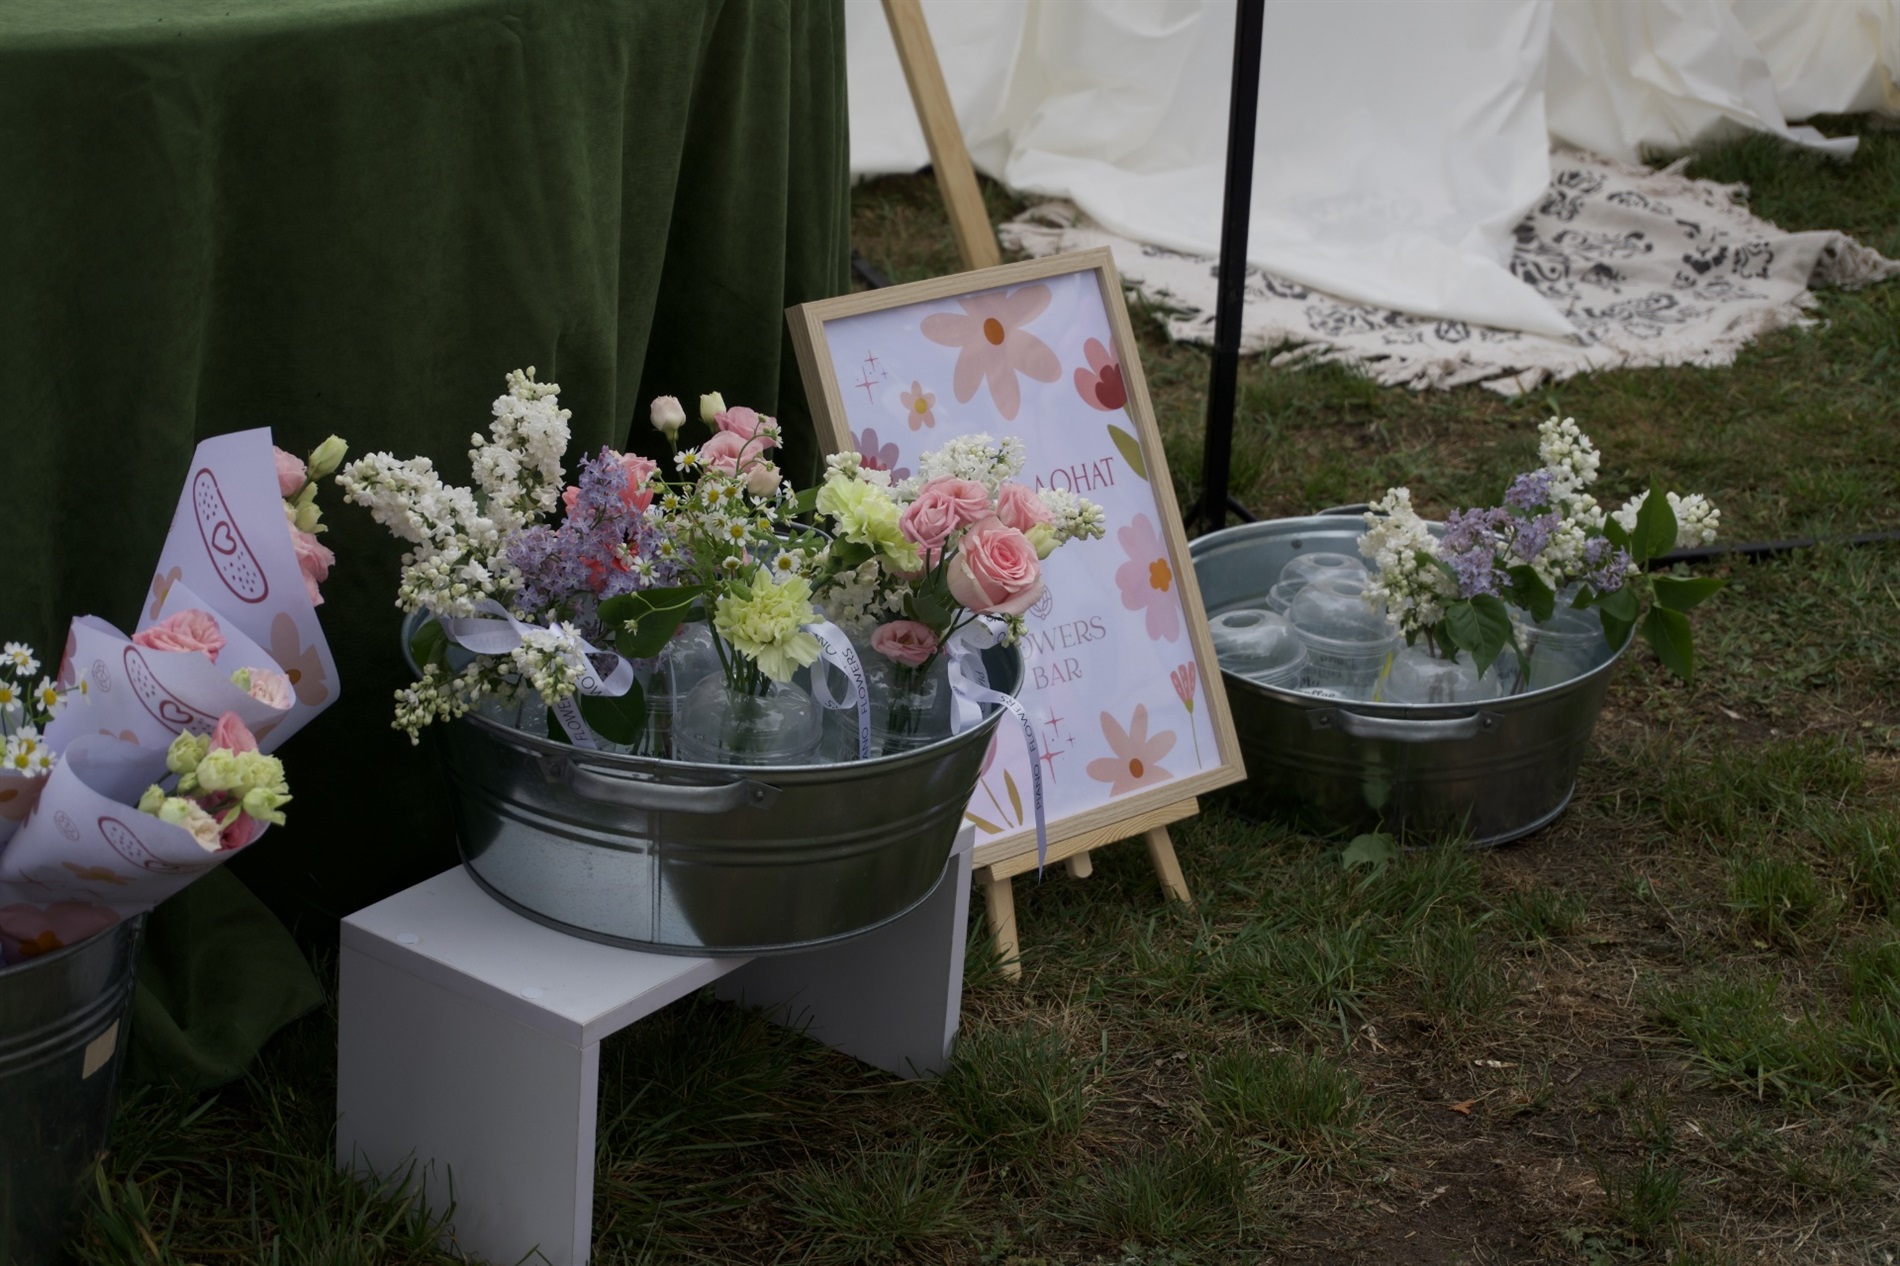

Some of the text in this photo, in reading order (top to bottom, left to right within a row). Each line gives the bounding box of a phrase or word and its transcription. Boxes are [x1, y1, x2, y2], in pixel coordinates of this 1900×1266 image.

[841, 641, 868, 714] FLOWERS
[1032, 657, 1082, 690] BAR
[999, 694, 1042, 810] PIANO FLOWERS
